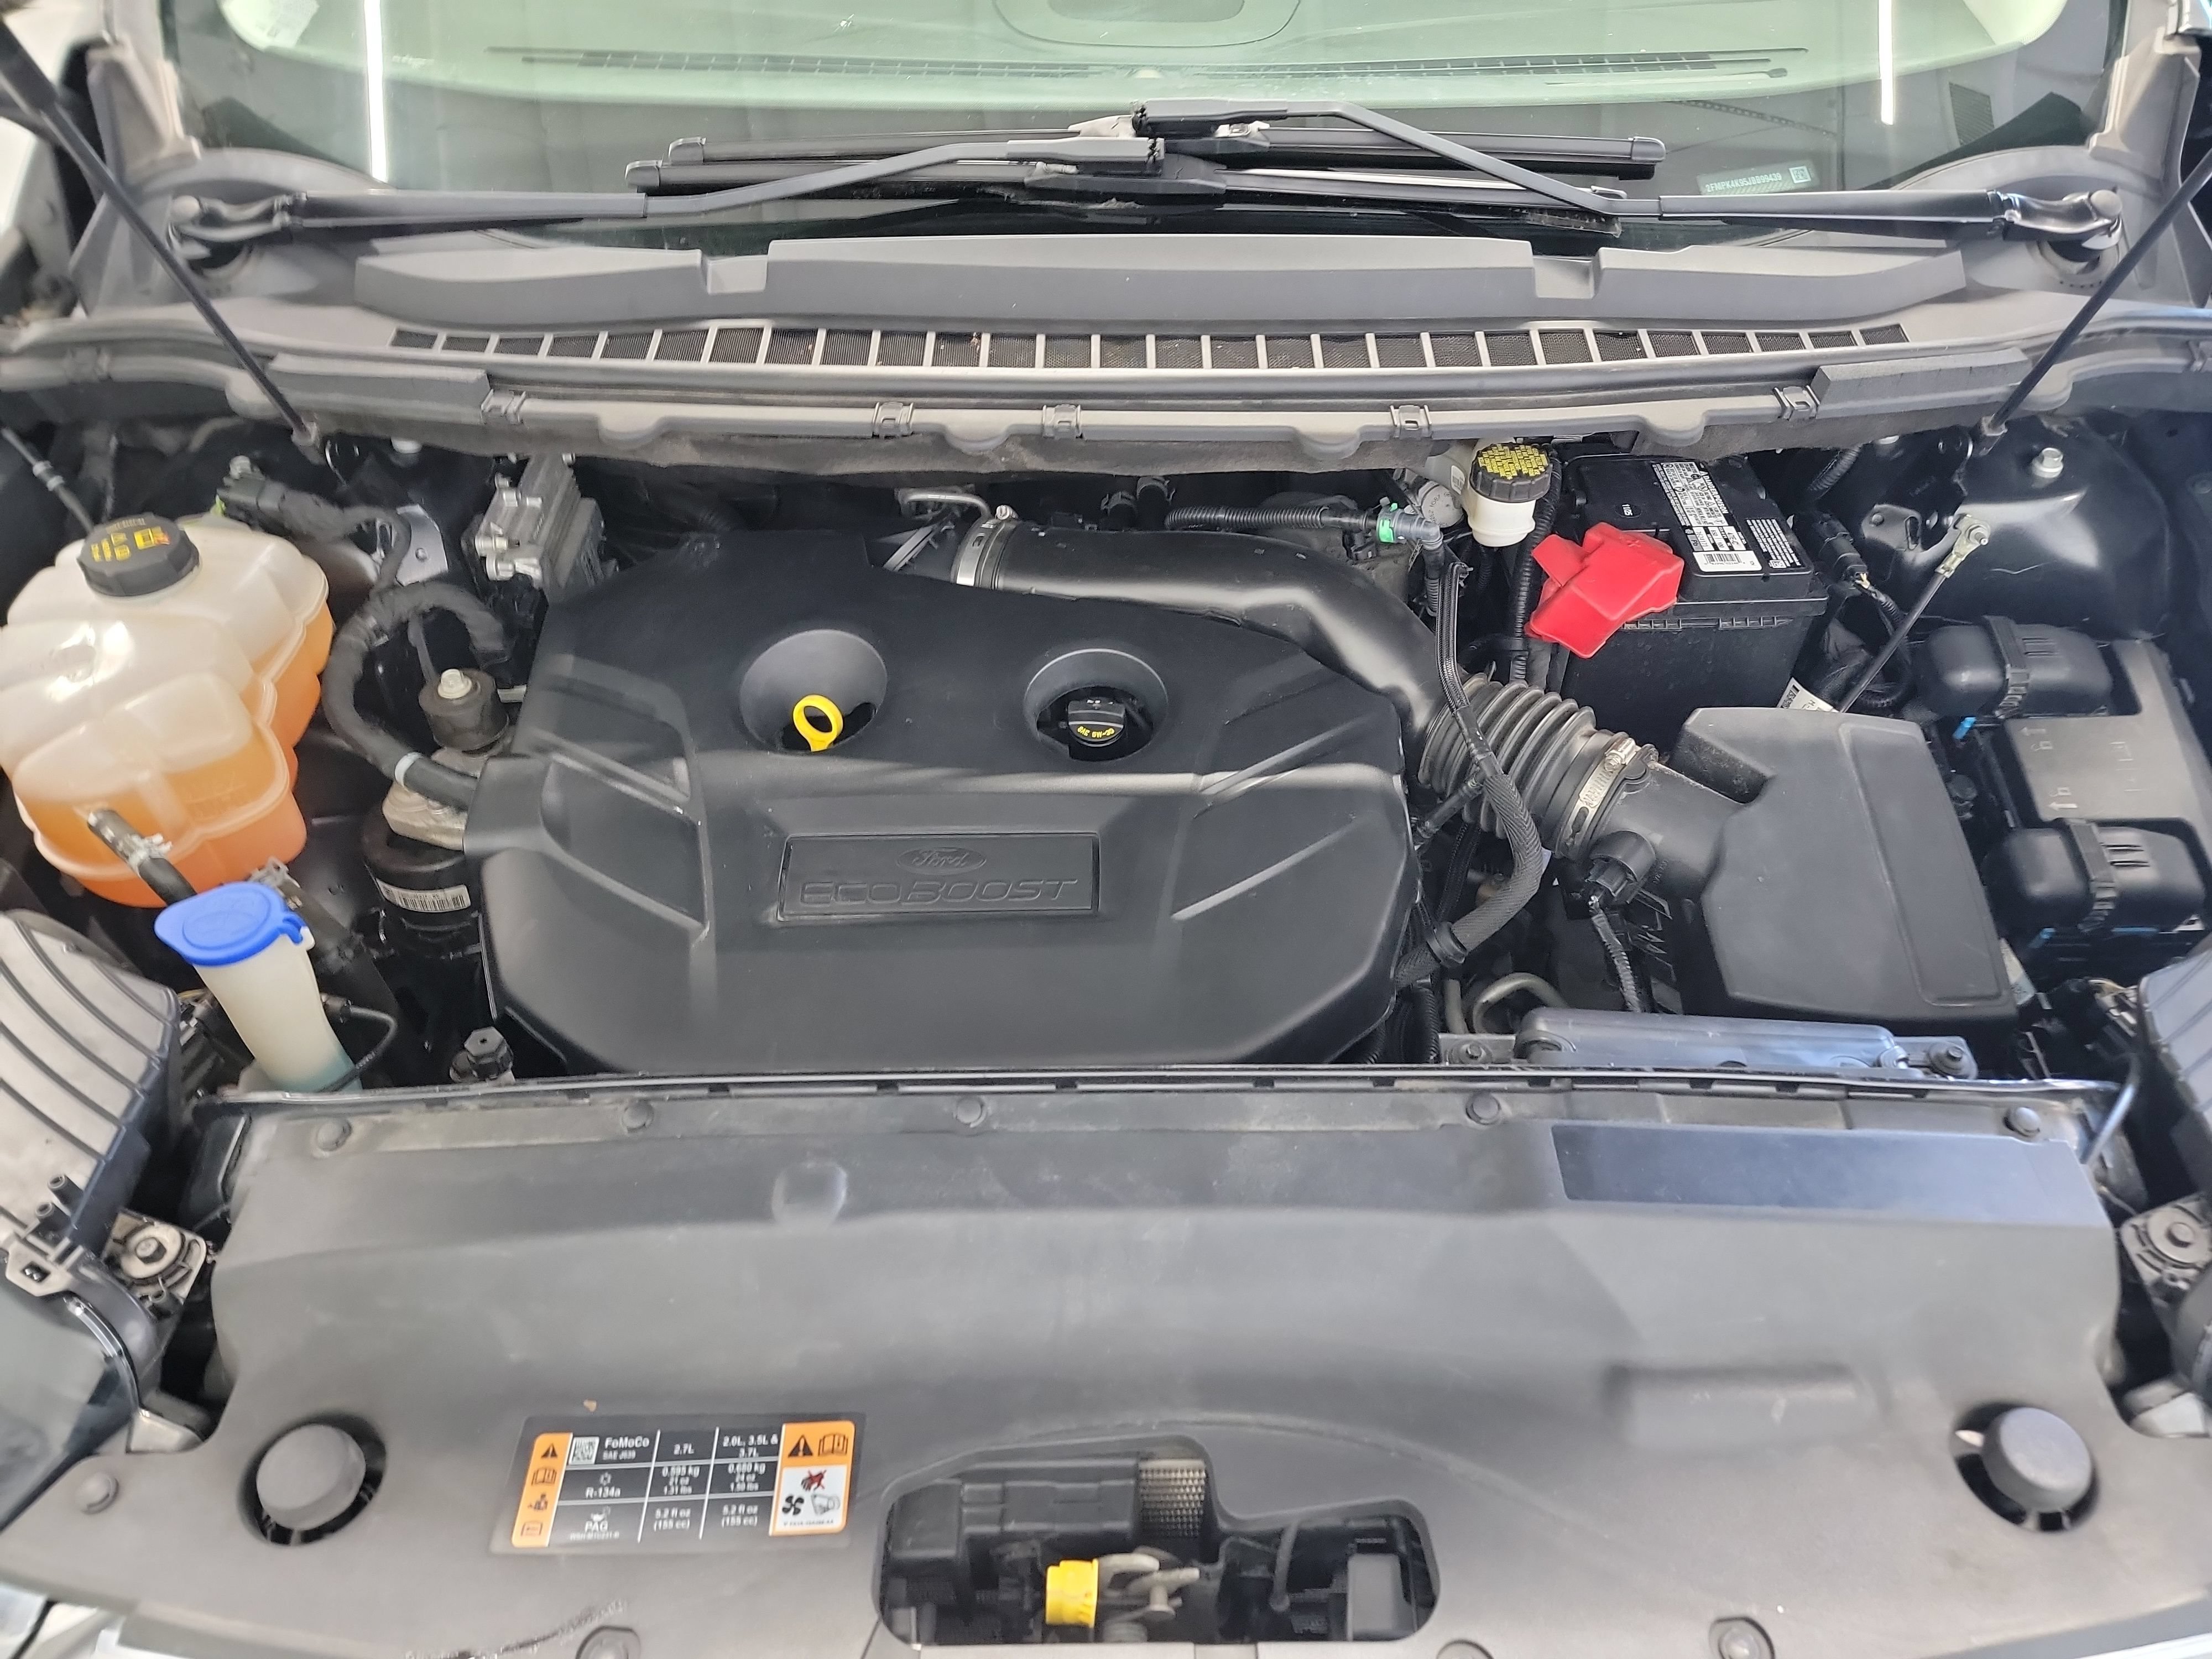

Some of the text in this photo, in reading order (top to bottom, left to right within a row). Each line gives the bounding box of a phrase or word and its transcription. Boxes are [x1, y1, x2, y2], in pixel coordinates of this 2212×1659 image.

[1077, 726, 1091, 737] SAE
[912, 849, 969, 867] Ford
[800, 879, 1078, 905] ECOBOOST
[604, 1436, 650, 1449] FoMoCo
[586, 1486, 621, 1499] R-134a
[585, 1521, 608, 1532] PAG
